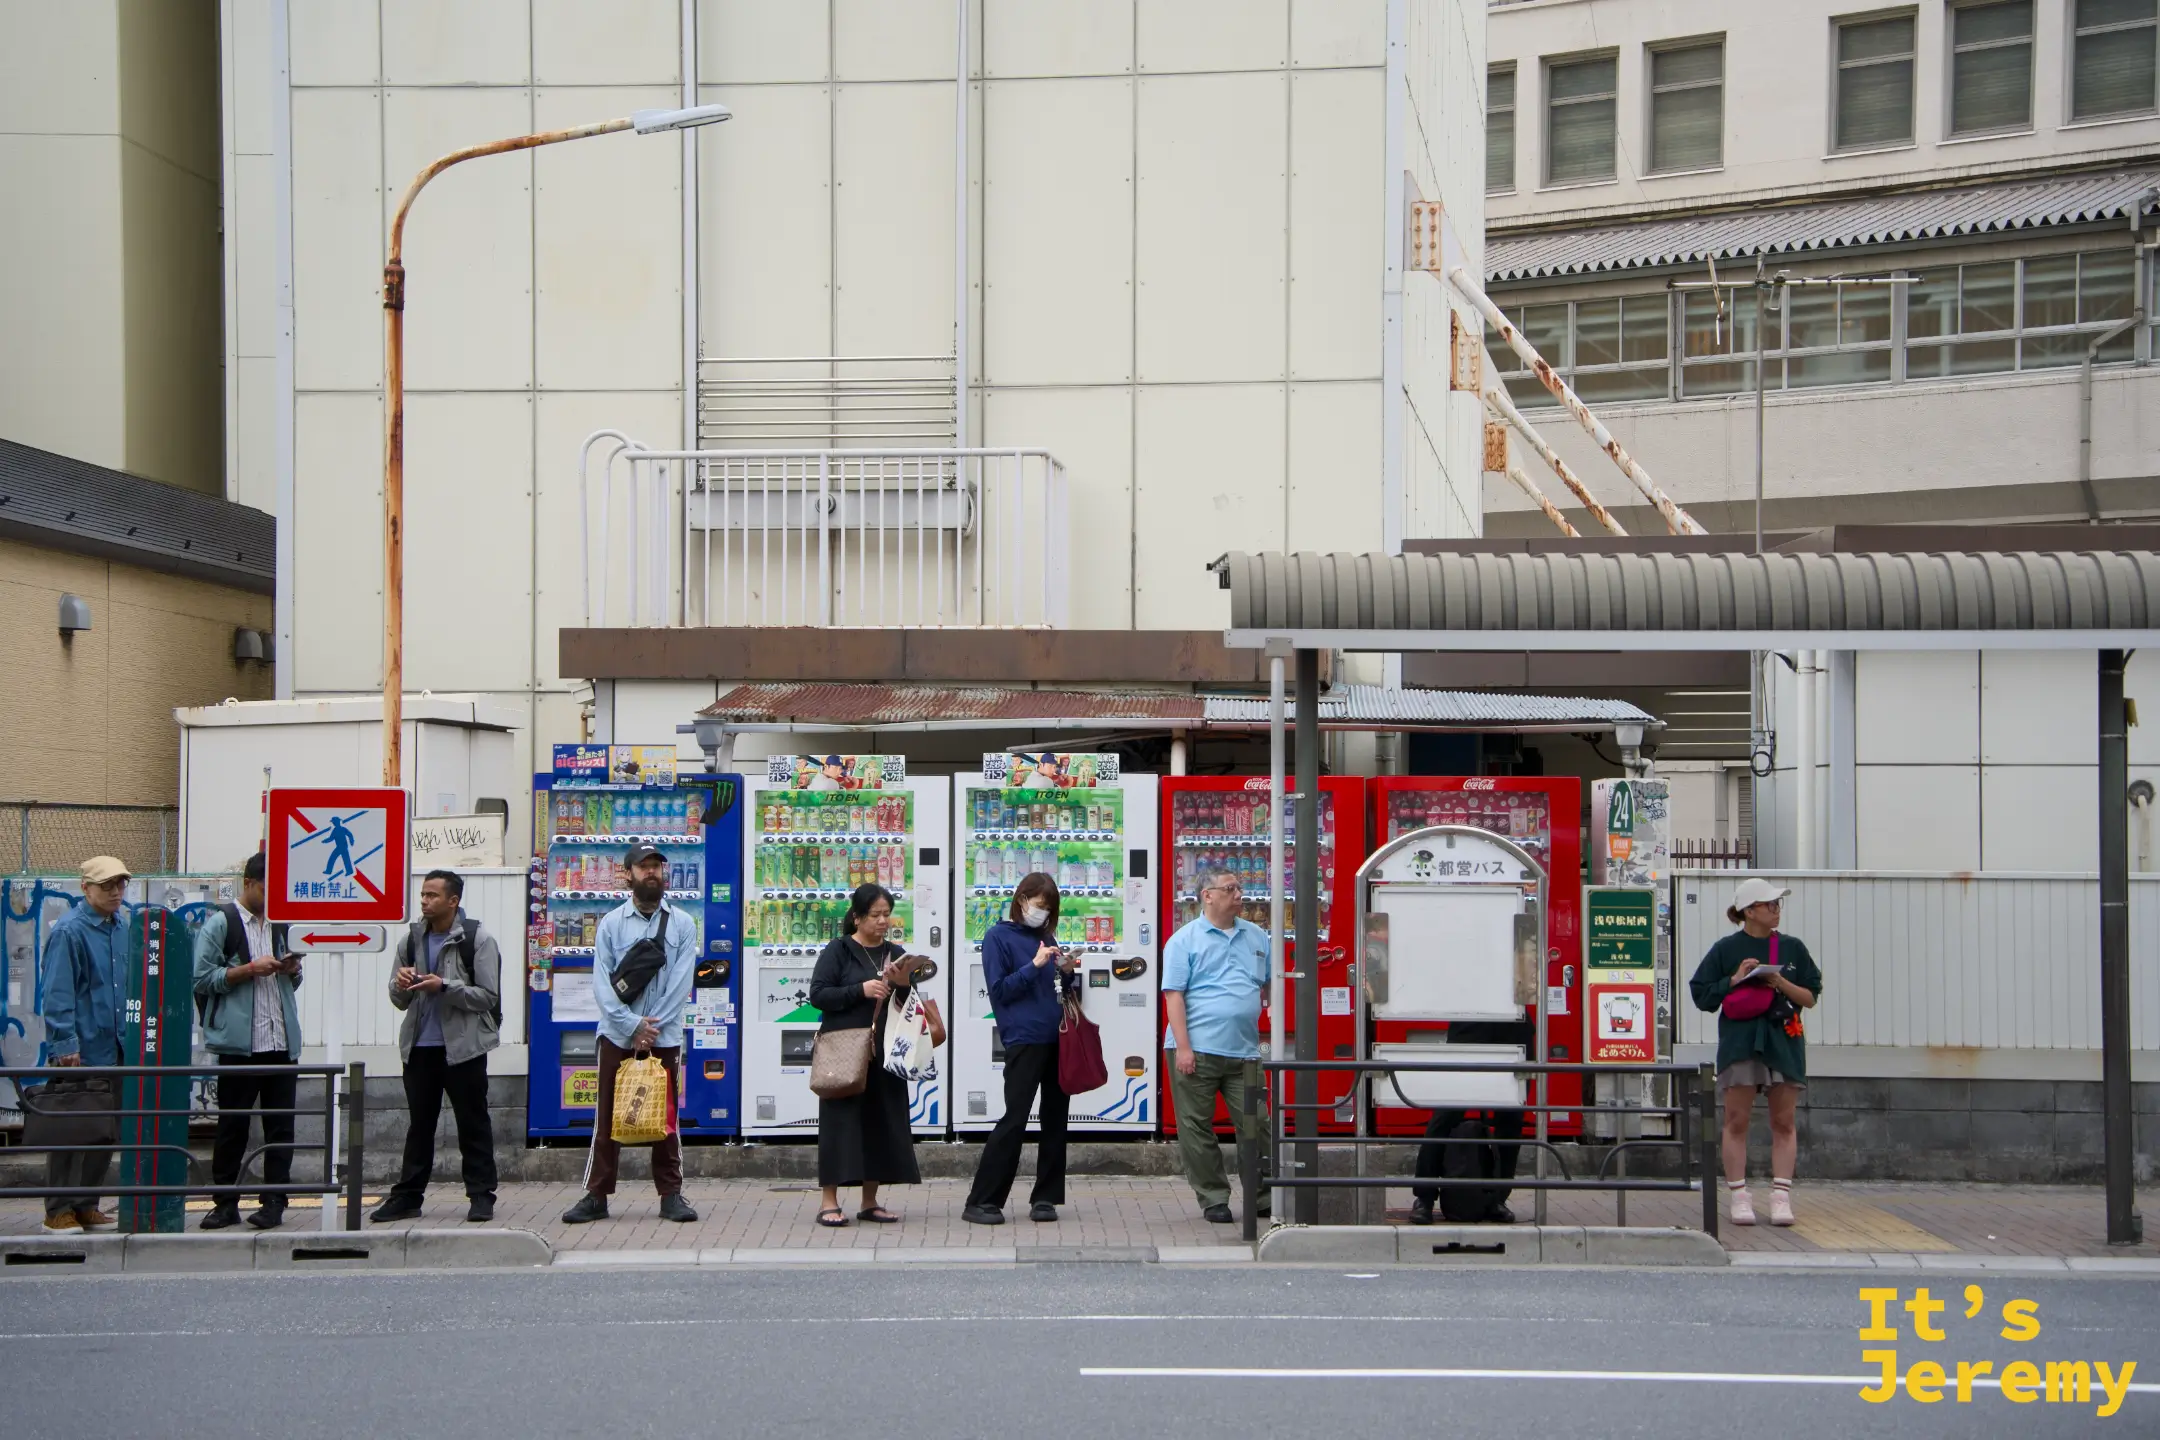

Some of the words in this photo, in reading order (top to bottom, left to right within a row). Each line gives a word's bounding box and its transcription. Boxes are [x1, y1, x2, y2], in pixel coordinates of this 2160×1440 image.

[556, 757, 576, 768] BIG
[769, 773, 788, 782] オトコ
[885, 772, 904, 782] トクホ
[985, 770, 1003, 779] オトコ
[1099, 770, 1118, 780] トクホ
[1244, 778, 1272, 790] Coca-Col
[1463, 778, 1496, 790] Coca-Cola
[825, 794, 844, 802] ITO
[846, 794, 860, 802] EN
[1034, 791, 1053, 799] ITO
[1055, 790, 1069, 799] EN
[1613, 790, 1630, 829] 24
[1439, 860, 1505, 877] 都営バス
[293, 881, 358, 899] 横断禁止
[1594, 915, 1647, 926] 浅草松屋西
[148, 939, 160, 976] 消火器
[145, 1016, 157, 1052] 台東区
[1597, 1048, 1647, 1058] 北めぐりん
